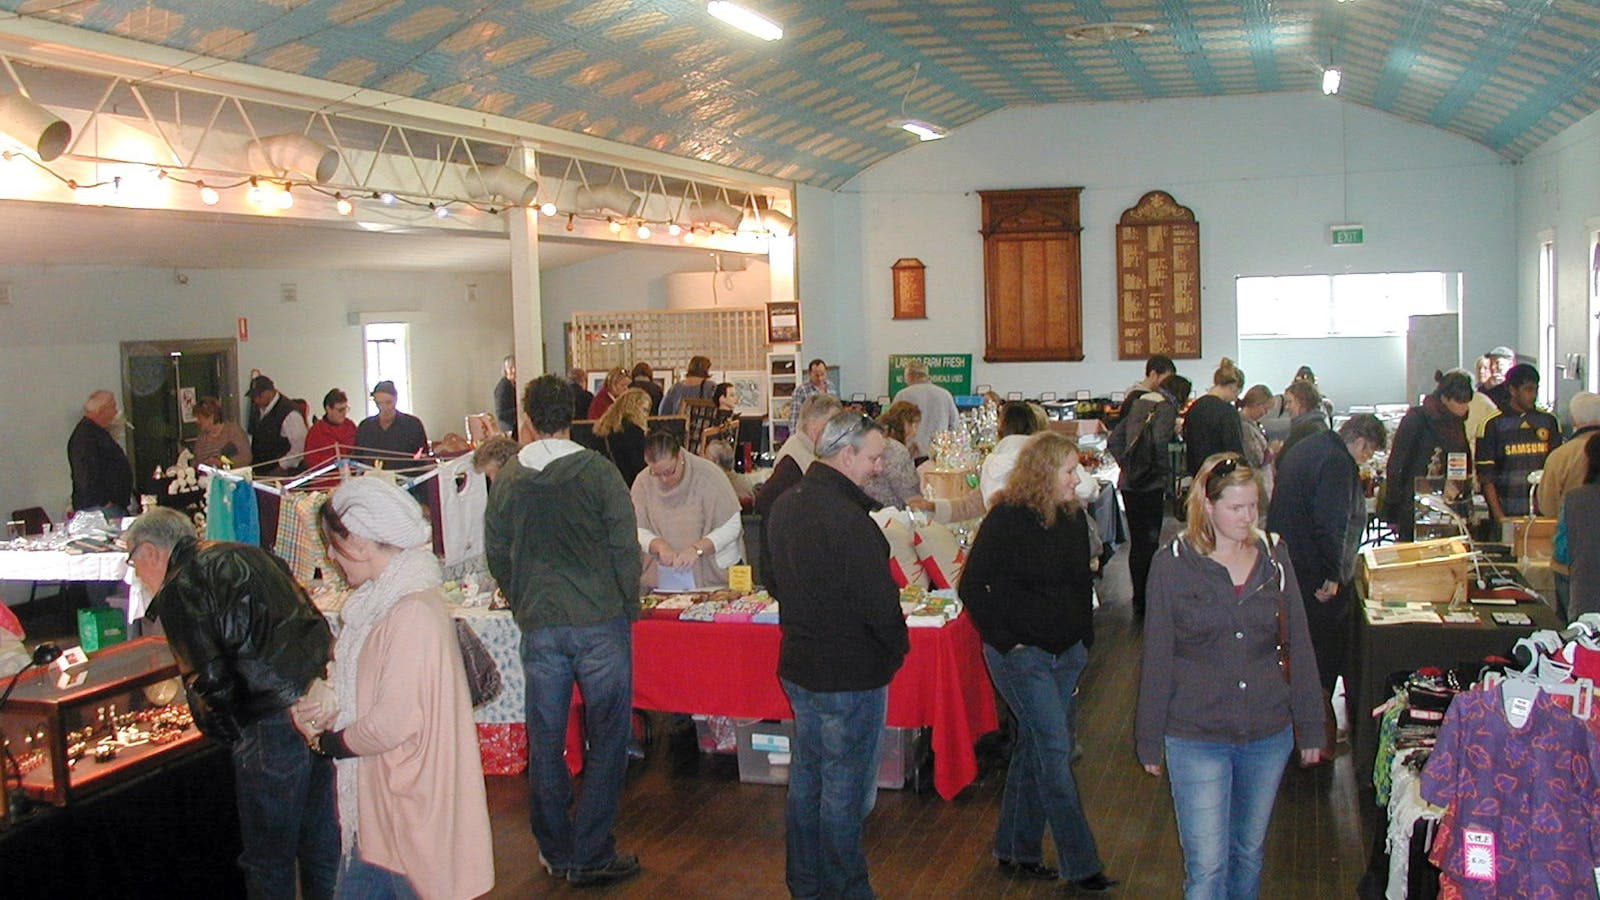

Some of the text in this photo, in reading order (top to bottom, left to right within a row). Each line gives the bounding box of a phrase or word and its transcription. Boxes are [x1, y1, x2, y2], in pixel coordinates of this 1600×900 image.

[1337, 231, 1358, 243] EXIT
[923, 357, 942, 368] FARM
[943, 357, 965, 368] FRESH
